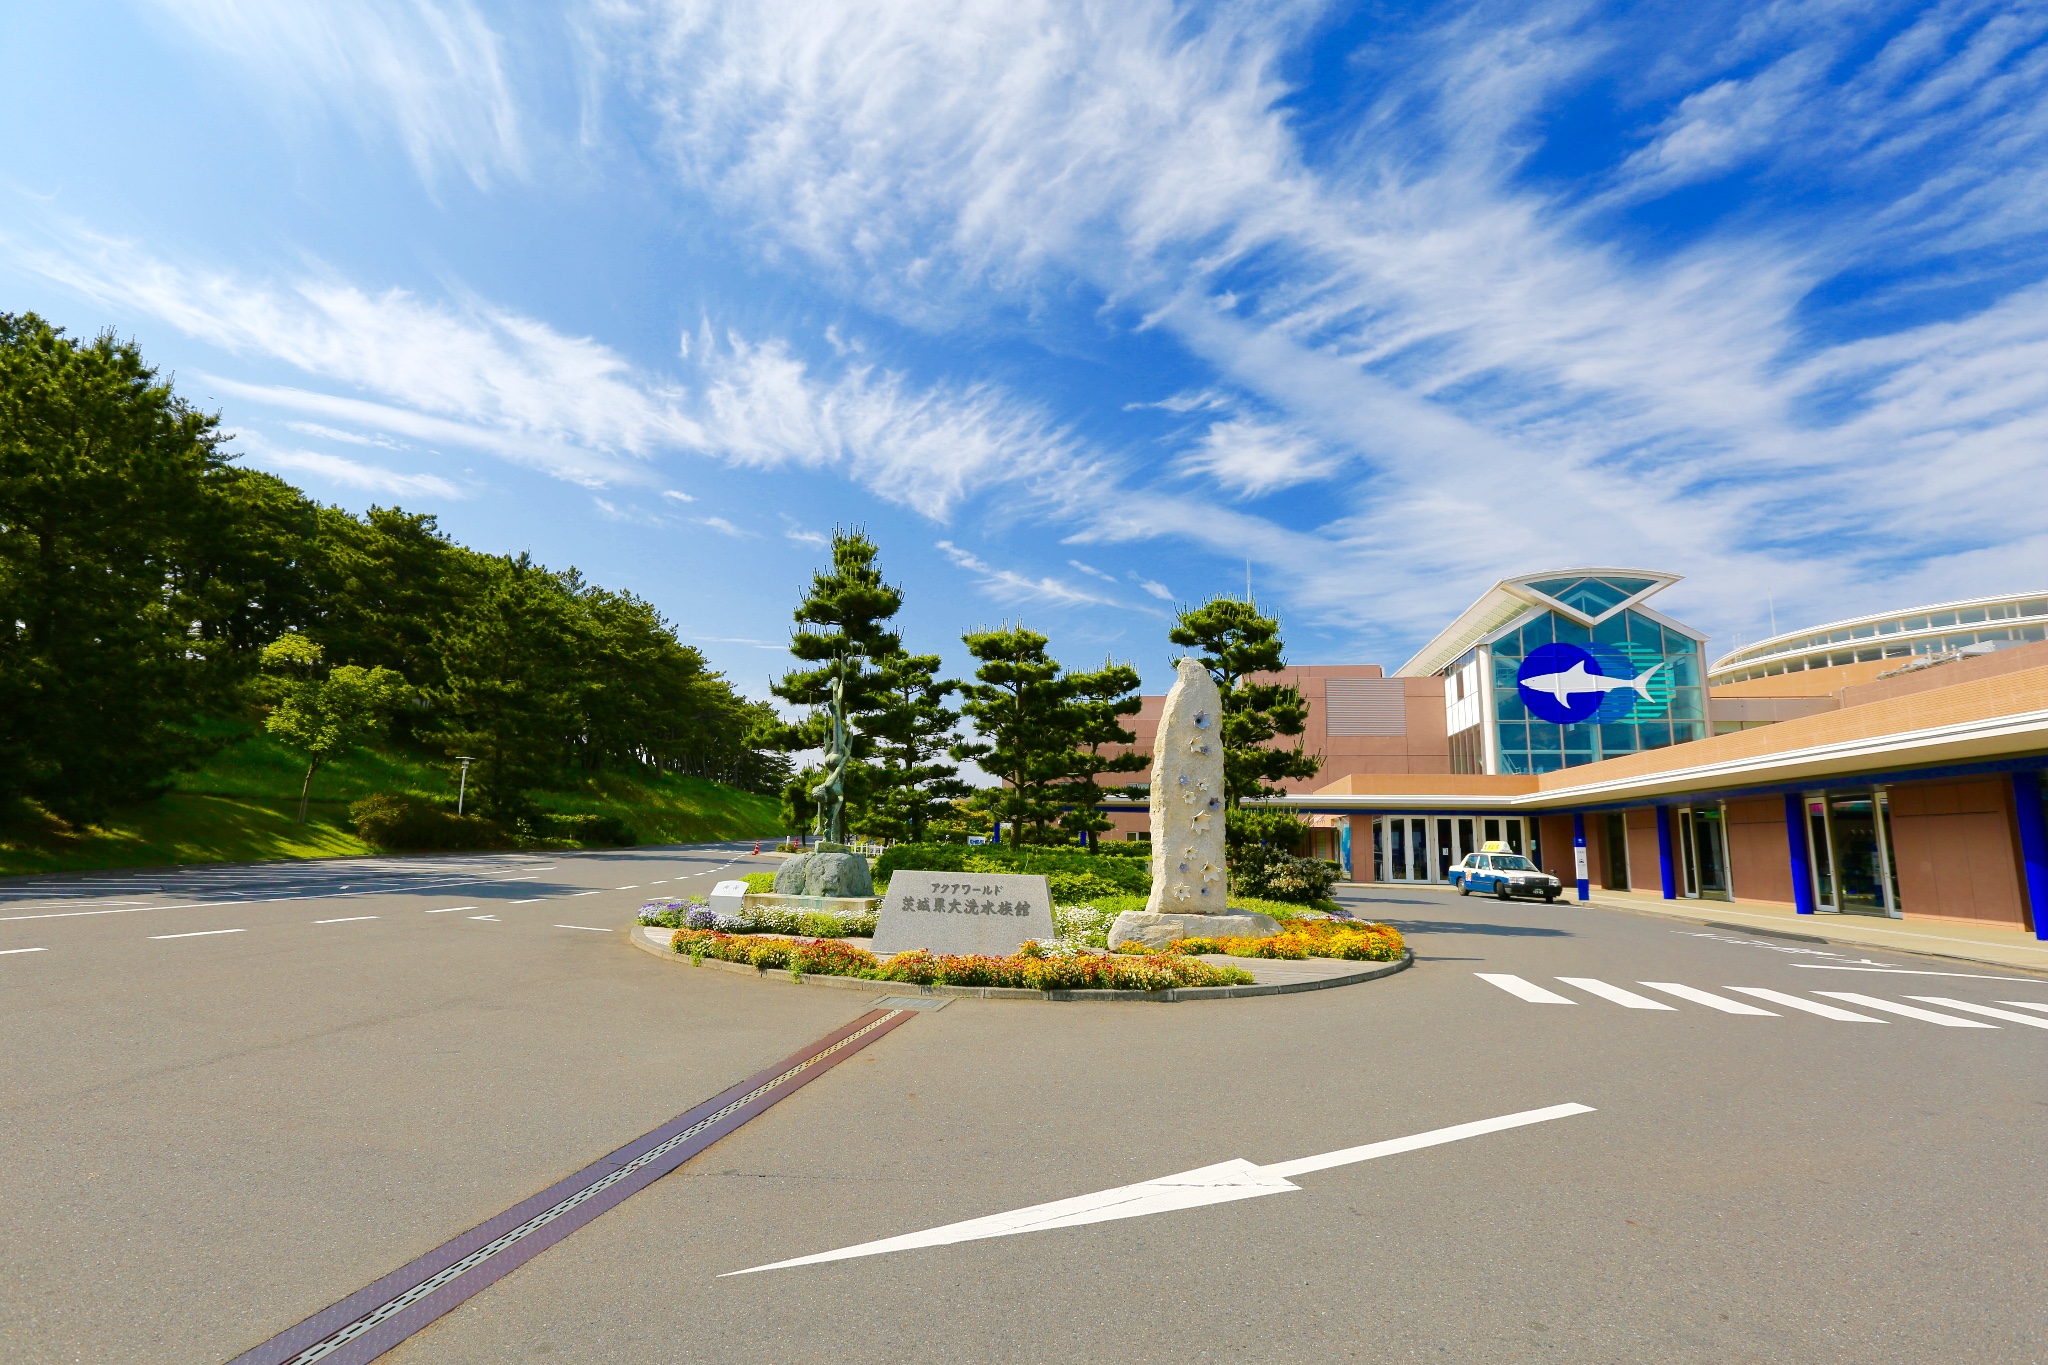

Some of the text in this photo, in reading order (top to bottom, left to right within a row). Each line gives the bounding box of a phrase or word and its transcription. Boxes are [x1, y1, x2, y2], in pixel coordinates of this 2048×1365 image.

[931, 883, 1003, 896] アクアワールド
[902, 896, 1031, 917] 茨城県大洗水族館
